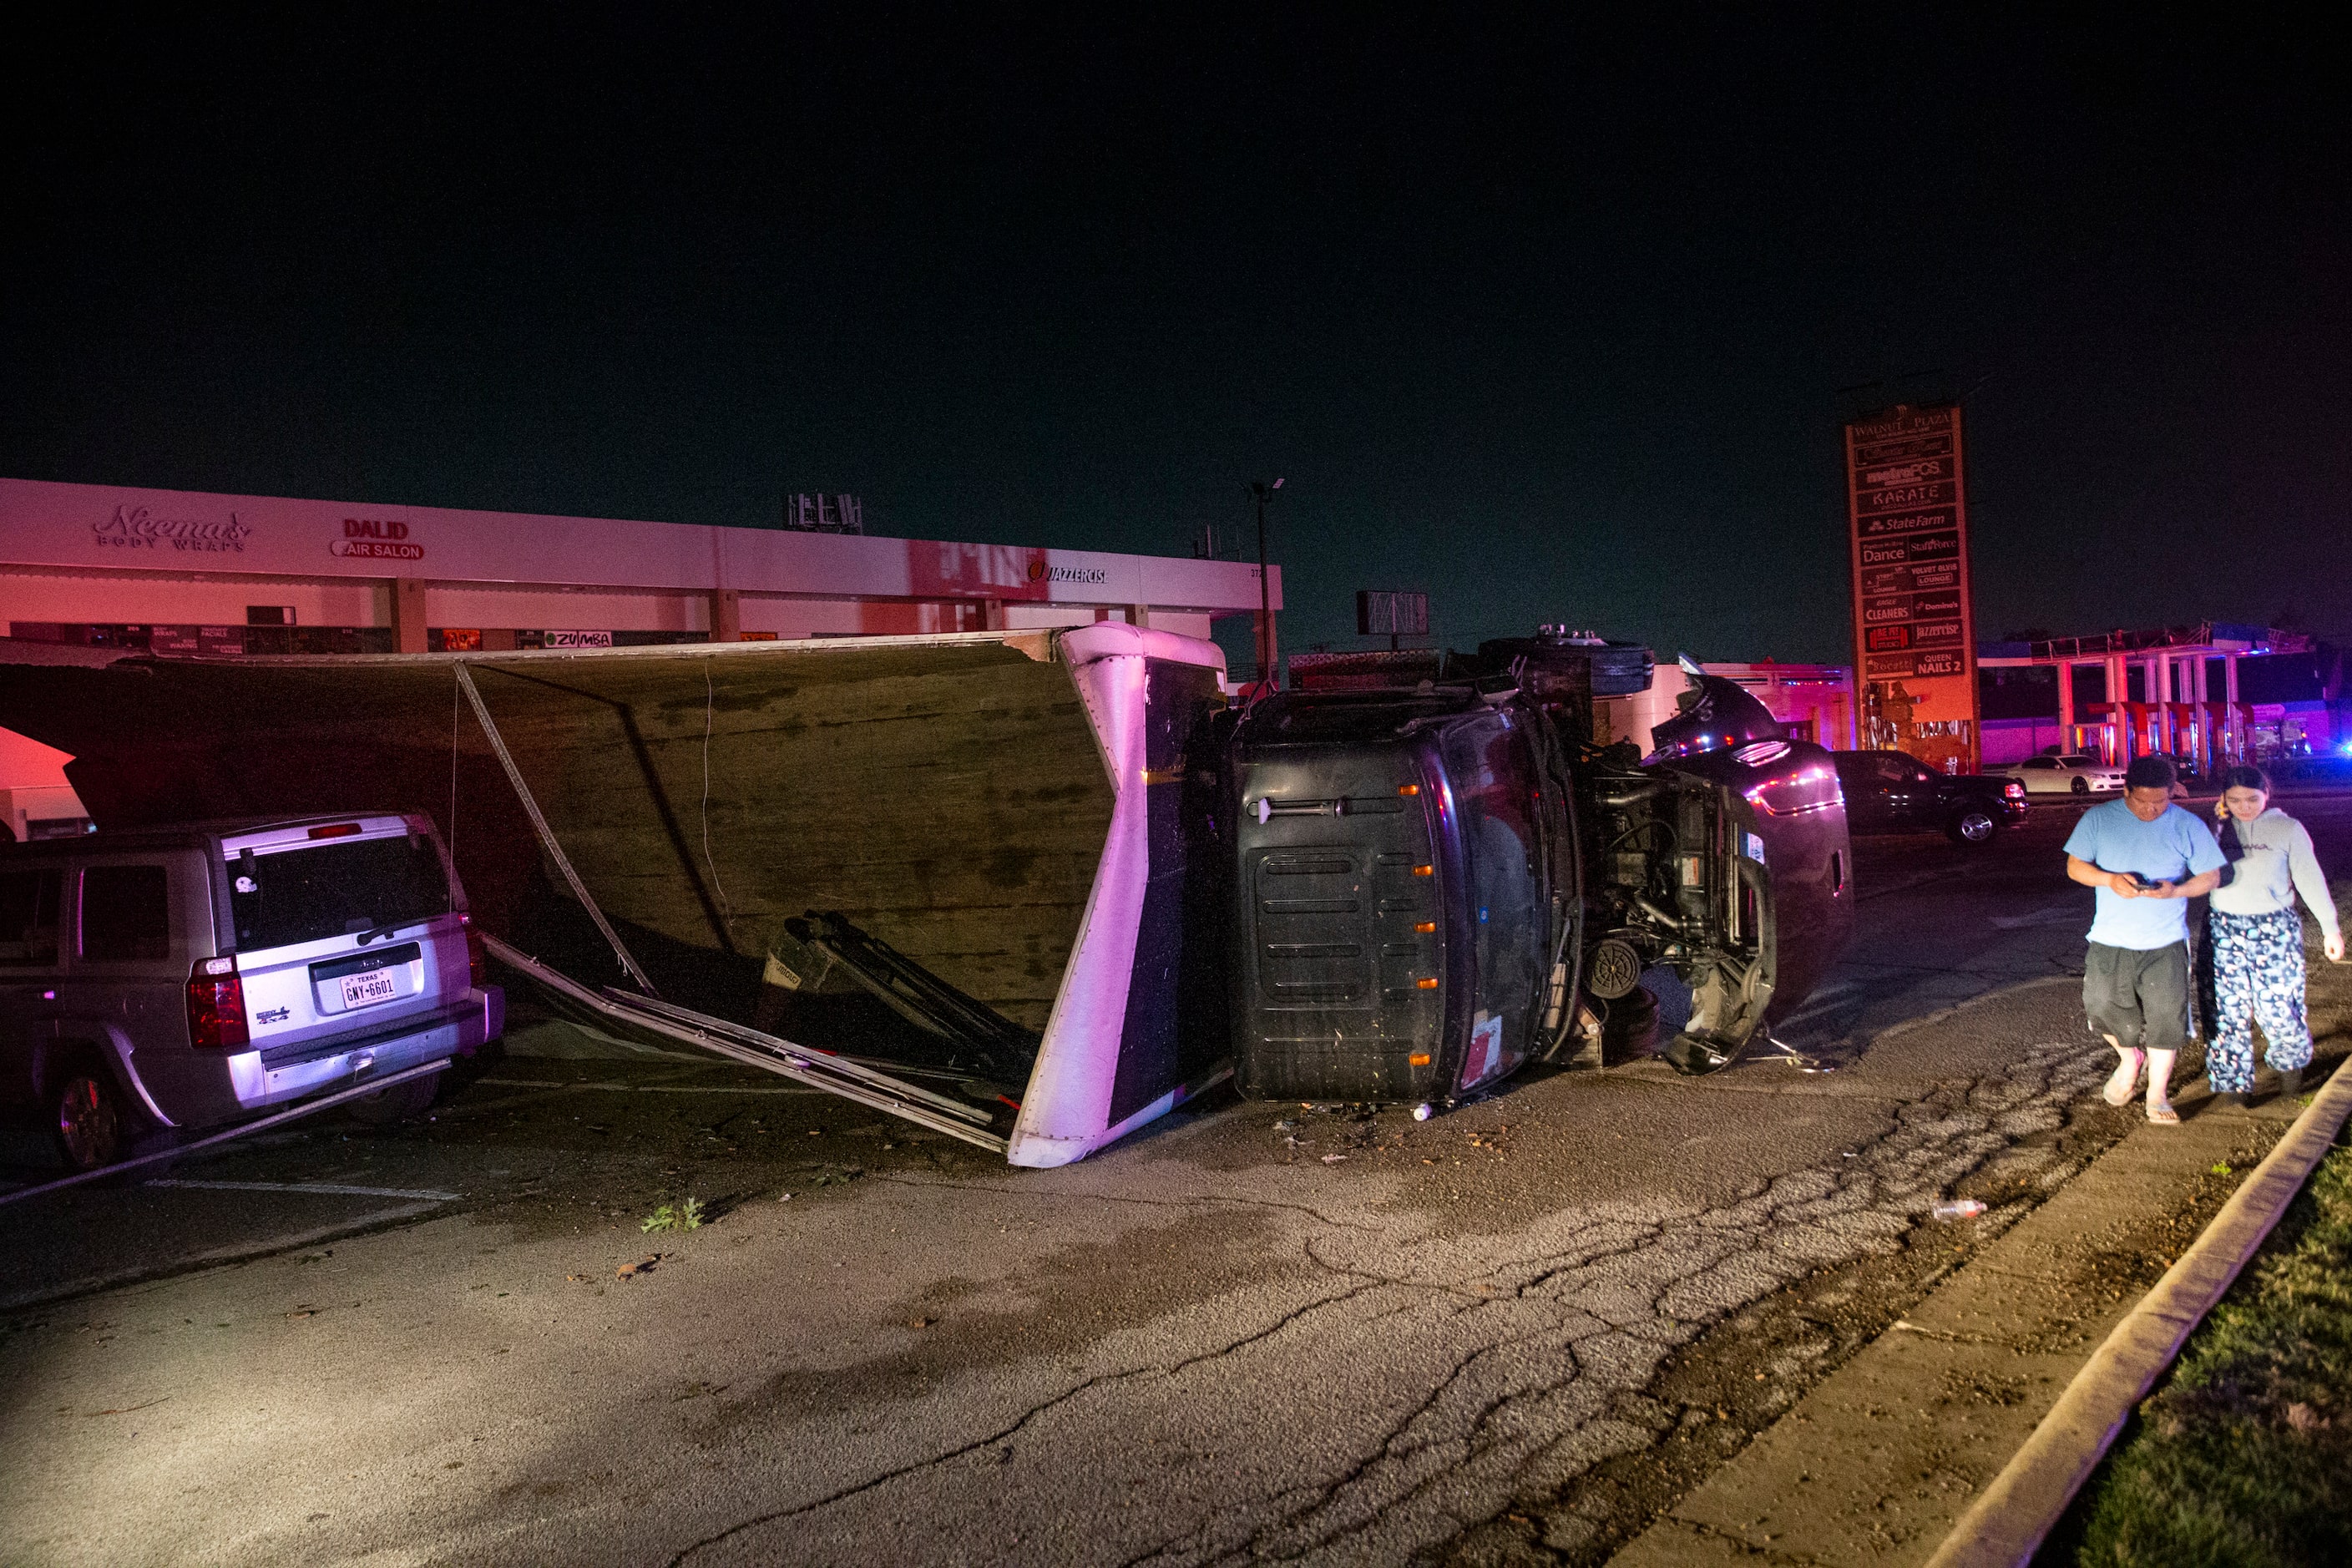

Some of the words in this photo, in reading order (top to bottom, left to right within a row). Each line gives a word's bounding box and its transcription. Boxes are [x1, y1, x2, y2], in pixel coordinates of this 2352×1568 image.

[1854, 422, 1903, 435] WALNUT
[1914, 414, 1950, 427] PLAZA
[1873, 485, 1939, 504] KARATE
[345, 518, 409, 539] DALID
[99, 535, 156, 548] BODY
[173, 539, 243, 552] WRAPS
[373, 544, 419, 559] SALON
[1864, 549, 1904, 562] Dance
[1919, 574, 1951, 584] LOUNGE
[1925, 601, 1959, 610] Domino's
[1866, 607, 1909, 620] CLEANERS
[556, 633, 611, 645] ZUMBA
[1924, 654, 1952, 663] QUEEN
[1918, 661, 1952, 674] NAILS
[1954, 661, 1961, 671] 2
[357, 974, 378, 983] TEXAS
